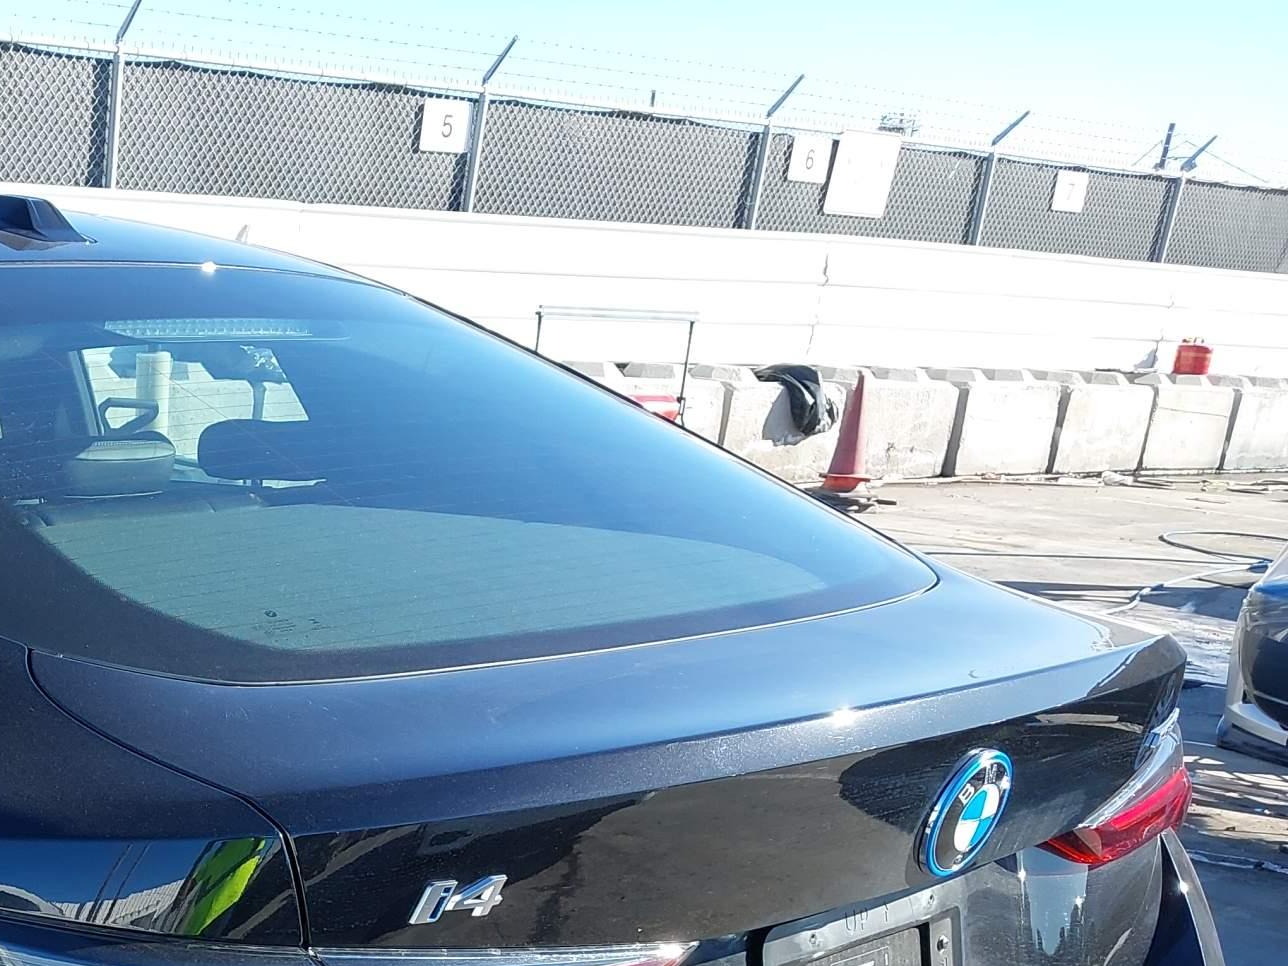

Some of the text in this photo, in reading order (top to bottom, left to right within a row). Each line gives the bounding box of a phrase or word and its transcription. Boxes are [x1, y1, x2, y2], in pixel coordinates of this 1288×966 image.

[441, 114, 454, 138] 5
[805, 149, 815, 170] 6
[408, 874, 508, 925] i4
